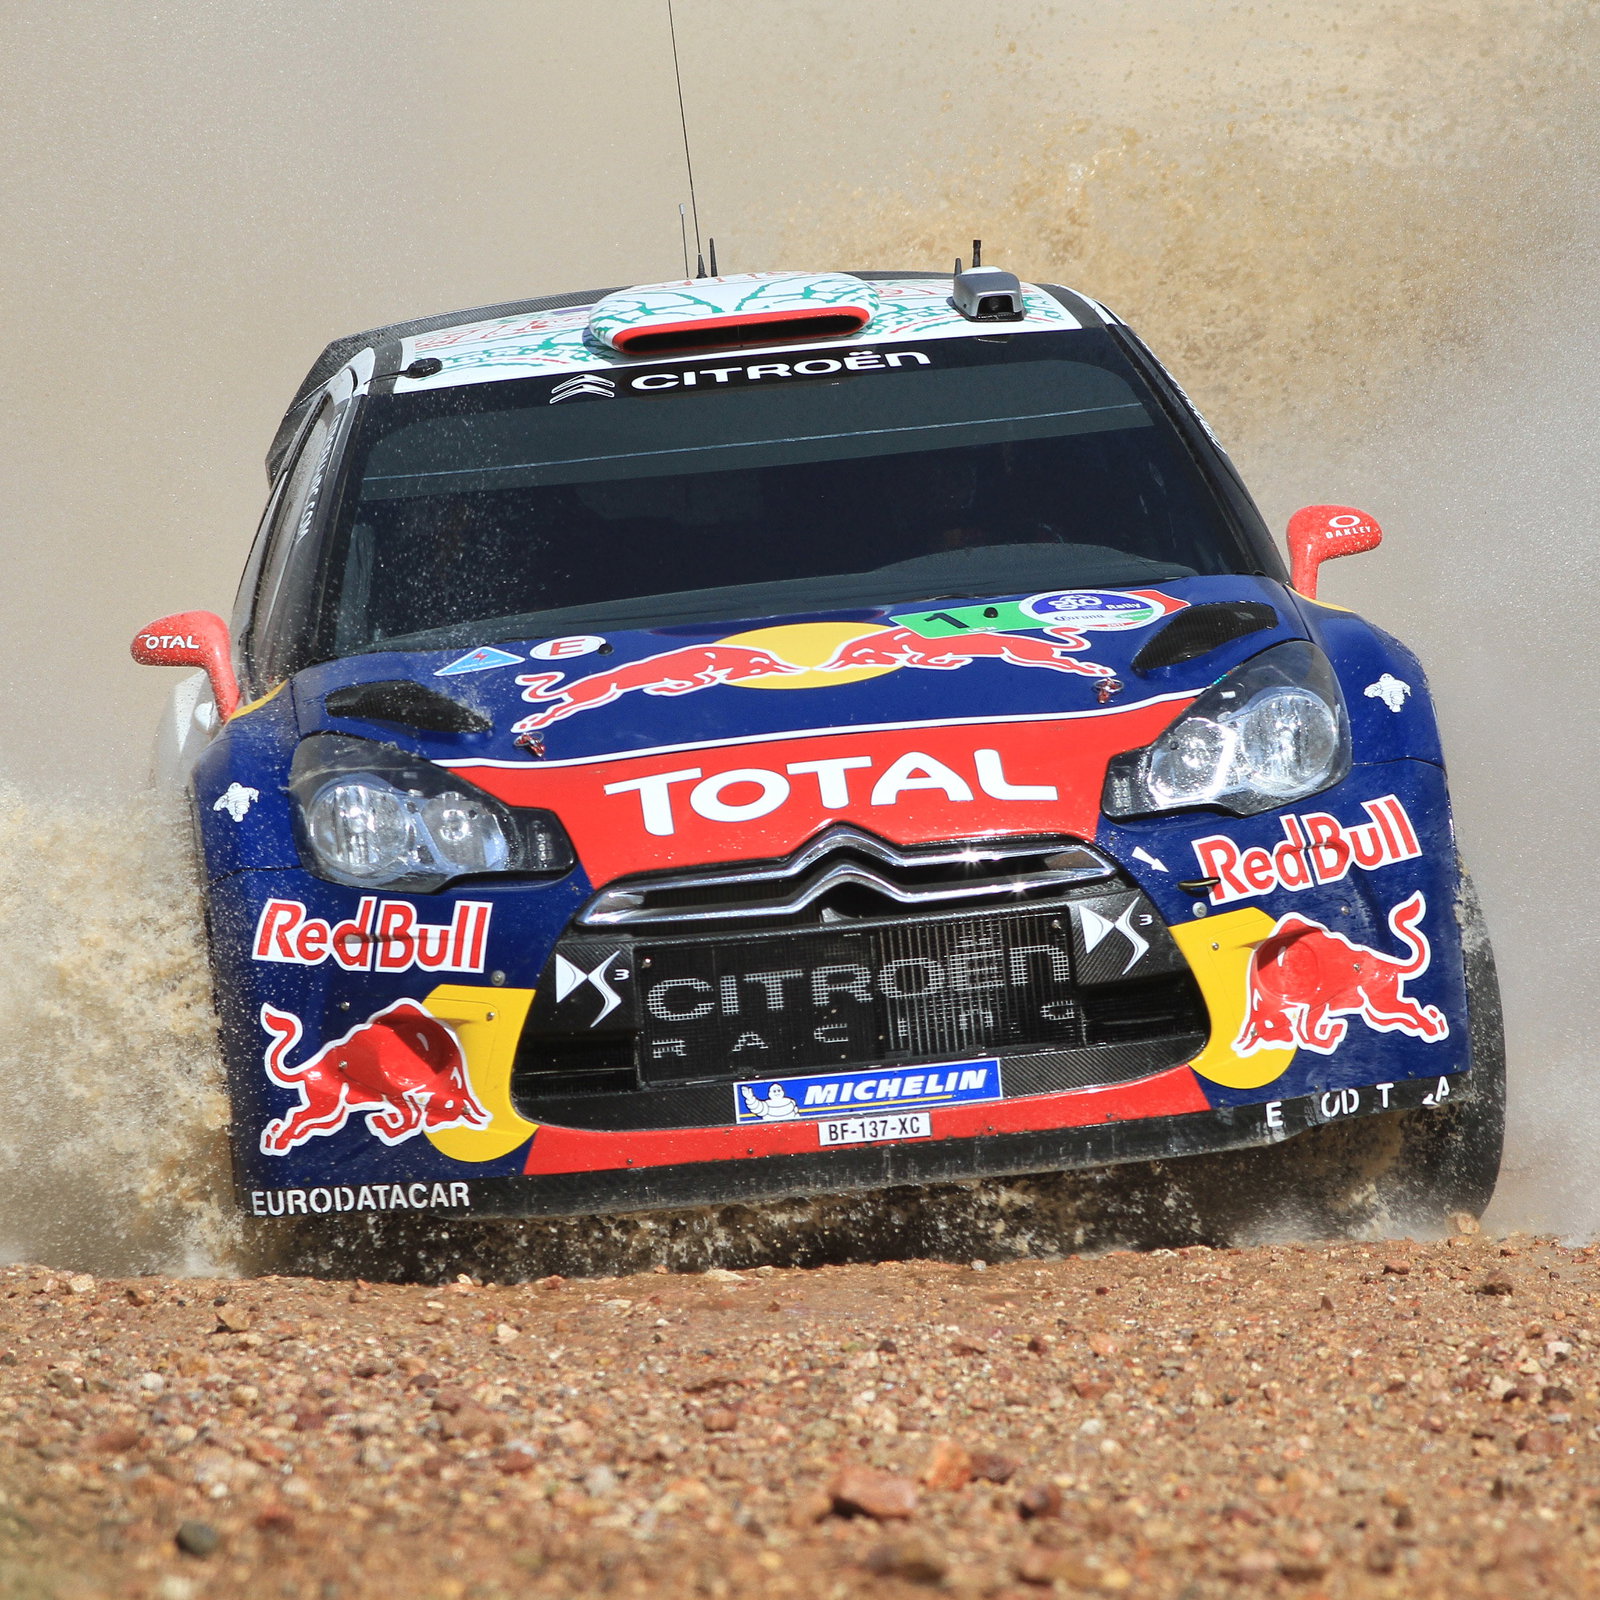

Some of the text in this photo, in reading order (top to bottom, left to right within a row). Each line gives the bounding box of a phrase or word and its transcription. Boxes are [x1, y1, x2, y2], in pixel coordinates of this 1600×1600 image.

[1325, 525, 1371, 539] OAKLEY
[1105, 602, 1142, 611] Rally
[923, 612, 970, 629] 1
[1053, 613, 1106, 623] Corona
[549, 638, 587, 656] E
[603, 748, 1058, 837] TOTAL
[803, 1069, 987, 1106] MICHELIN
[828, 1115, 922, 1142] BF-137-XC
[250, 1181, 471, 1217] EURODATACAR
